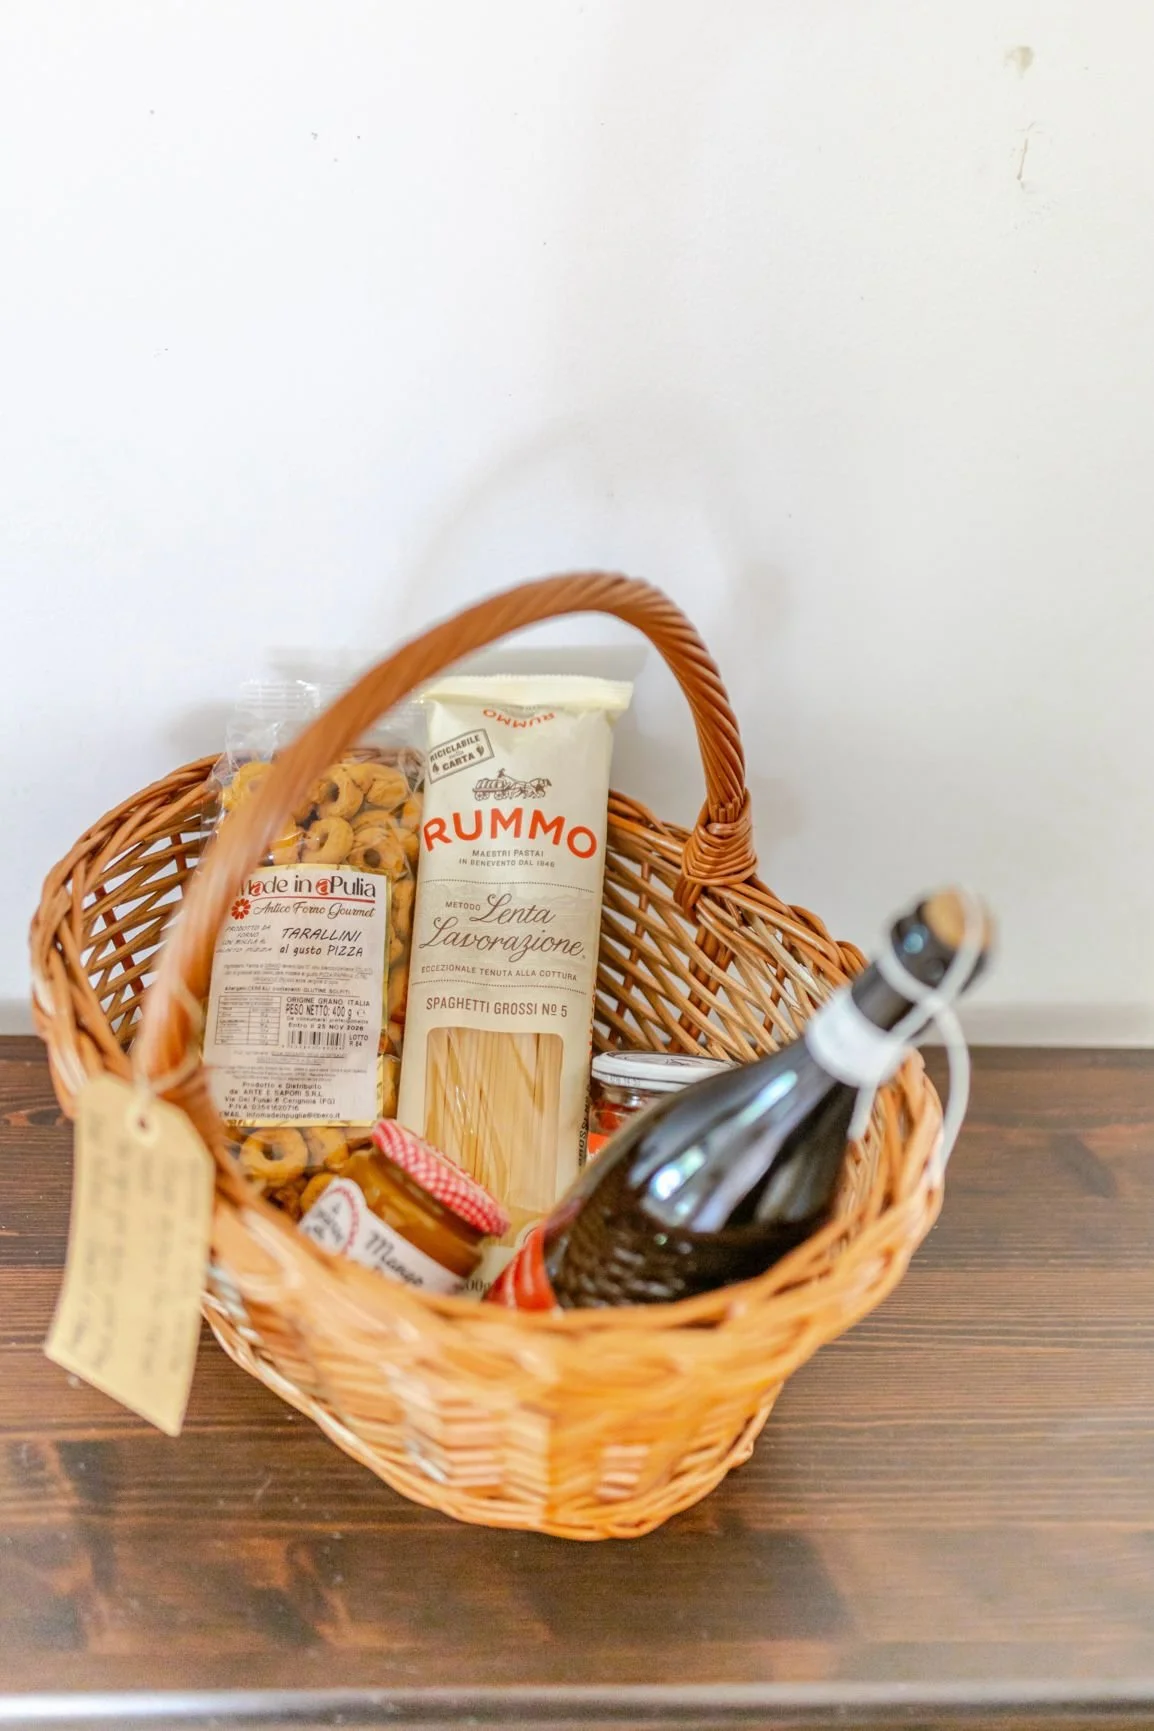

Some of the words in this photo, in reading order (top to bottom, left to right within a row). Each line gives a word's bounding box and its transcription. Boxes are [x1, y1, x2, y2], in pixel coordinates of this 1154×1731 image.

[483, 708, 555, 728] RUMMO
[430, 734, 480, 762] RICICLABILE
[442, 752, 476, 771] CARTA
[423, 807, 597, 859] RUMMO
[472, 849, 511, 858] MAESTRI
[513, 849, 544, 857] PASTAI
[470, 859, 516, 867] BENEVENTO
[293, 874, 312, 893] in
[253, 901, 290, 915] Antico
[292, 901, 325, 914] Forno
[327, 902, 375, 919] Gourmet
[445, 901, 481, 911] METODO
[469, 893, 557, 925] Lenta
[282, 927, 361, 942] TARALLINI
[279, 943, 290, 953] al
[293, 945, 322, 956] gusto
[327, 945, 363, 957] PIZZA
[421, 964, 476, 974] ECCEZIONALE
[480, 968, 513, 978] TENUTA
[516, 969, 536, 977] ALLA
[539, 970, 577, 982] COTTURA
[286, 996, 313, 1004] ORIGINE
[426, 997, 490, 1013] SPAGHETTI
[494, 1002, 537, 1015] GROSSI
[561, 1005, 568, 1018] 5
[286, 1003, 304, 1015] PESO
[306, 1005, 330, 1016] NETTO:
[332, 1006, 345, 1017] 400
[348, 1009, 352, 1019] g
